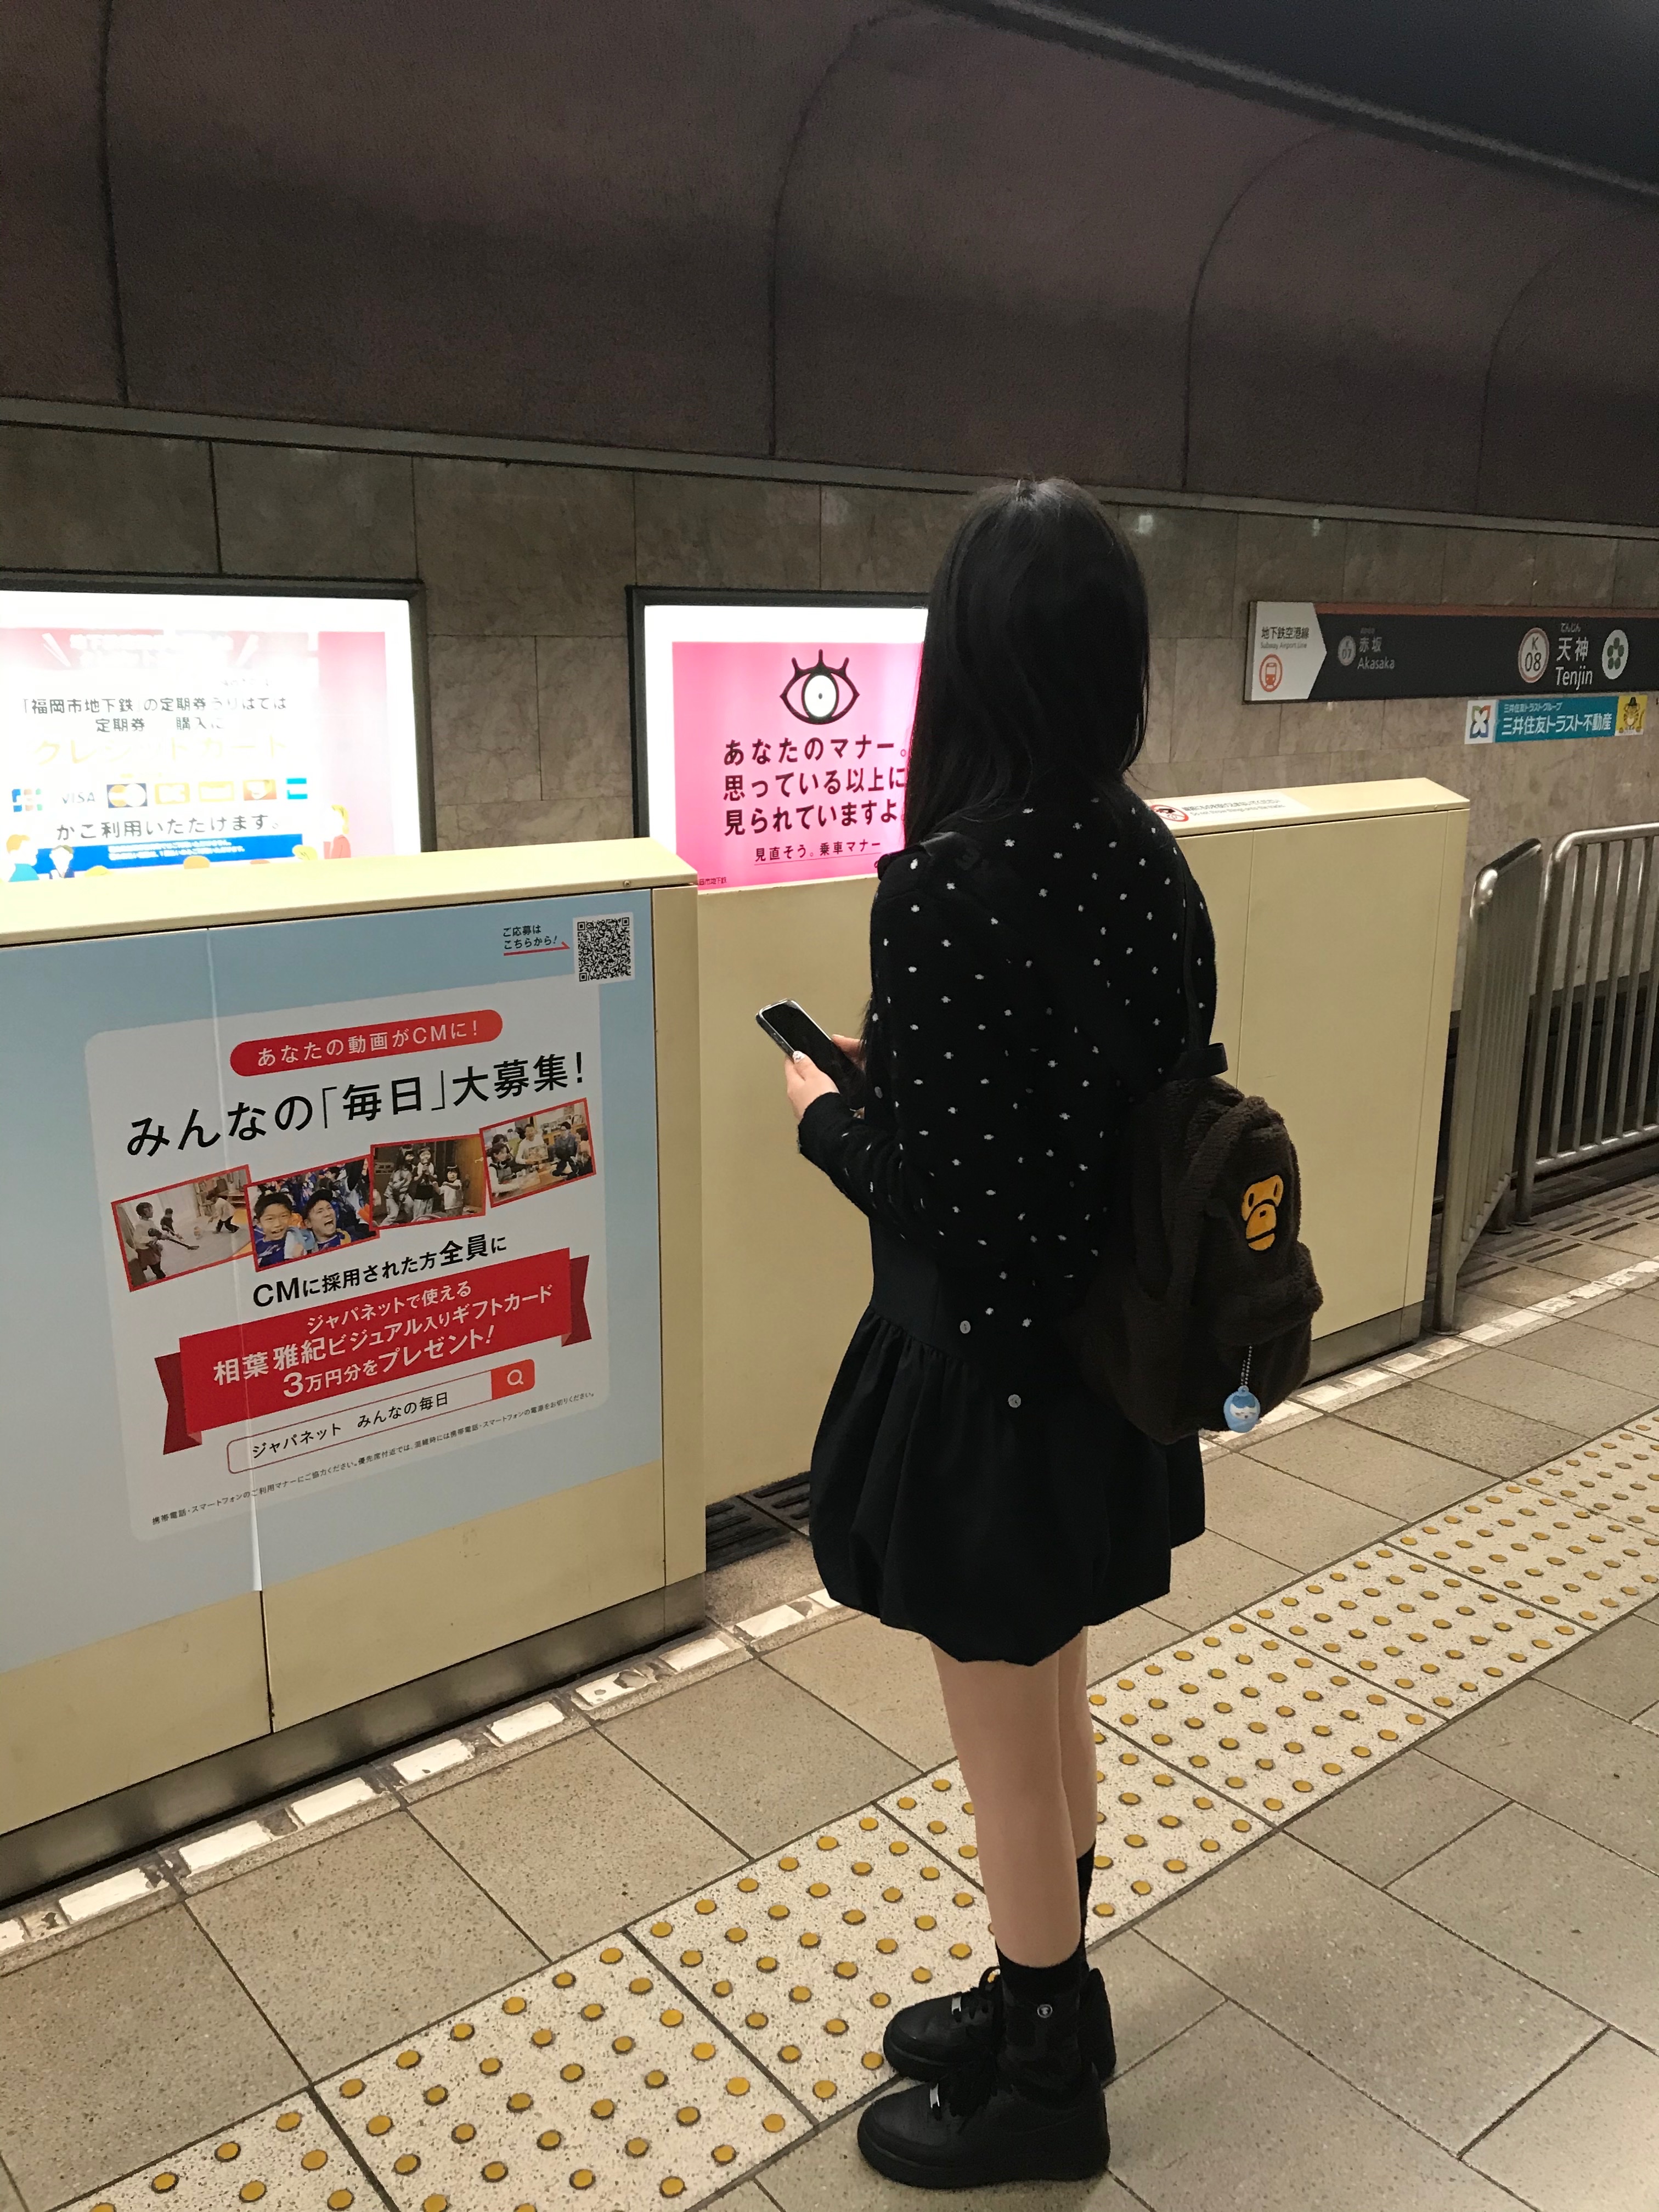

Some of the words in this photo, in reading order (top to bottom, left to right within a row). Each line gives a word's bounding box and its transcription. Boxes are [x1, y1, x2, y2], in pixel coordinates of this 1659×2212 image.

[1261, 626, 1310, 639] 地下鉄空港線
[1358, 636, 1383, 652] 赤坂
[1532, 636, 1539, 650] K
[1342, 648, 1352, 659] 07
[1556, 636, 1589, 662] 天神
[1357, 657, 1395, 669] Akasaka
[1525, 652, 1542, 672] 08
[1555, 665, 1593, 690] Tenjin
[1502, 713, 1612, 736] 三井住友トラスト不動産
[724, 734, 907, 766] あなたのマナー。
[723, 766, 906, 801] 思っている以上に
[62, 792, 96, 804] VISA
[724, 799, 898, 836] 見られていますよ
[755, 839, 881, 862] 見直そう。乗車マナー
[503, 924, 541, 937] ご応募は
[253, 1233, 506, 1307] CMに採用された方全員に
[308, 1280, 472, 1334] ジャパネットで使える
[252, 1423, 341, 1459] ジャパネット
[357, 1391, 448, 1429] みんなの毎日
